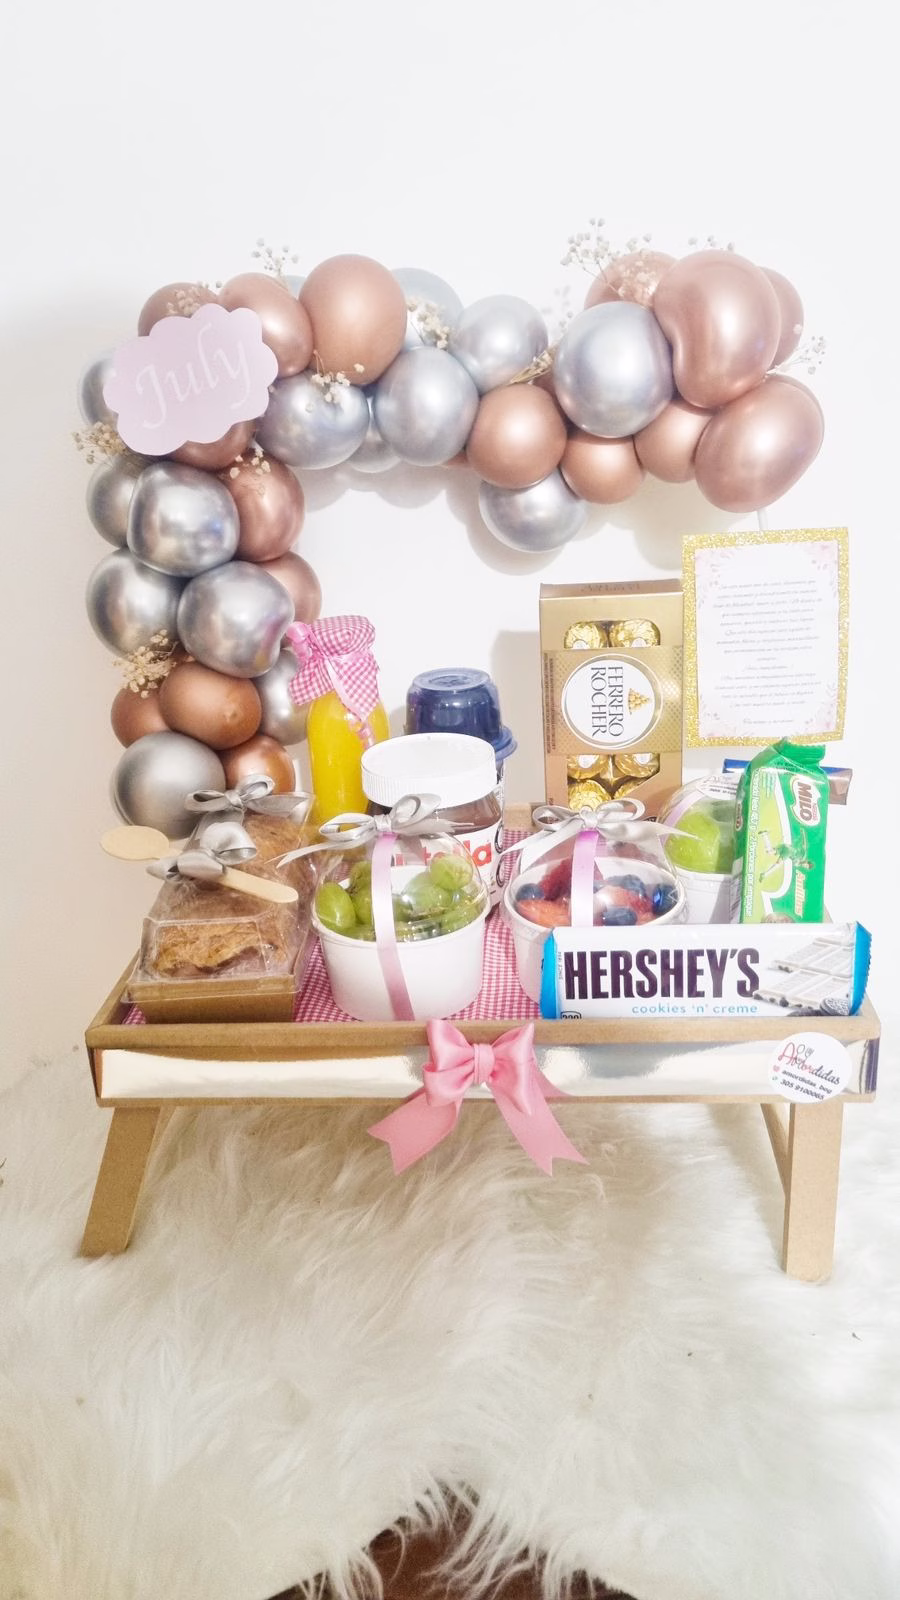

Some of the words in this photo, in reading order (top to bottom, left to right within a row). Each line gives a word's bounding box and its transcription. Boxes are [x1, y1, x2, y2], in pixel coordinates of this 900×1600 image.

[136, 322, 252, 430] July
[590, 666, 608, 737] ROCHER
[608, 666, 625, 737] FERRERO
[798, 782, 813, 821] MILO
[563, 948, 760, 1000] HERSHEY'S
[631, 1003, 687, 1015] cookies
[713, 1004, 758, 1015] creme
[780, 1078, 794, 1088] 305
